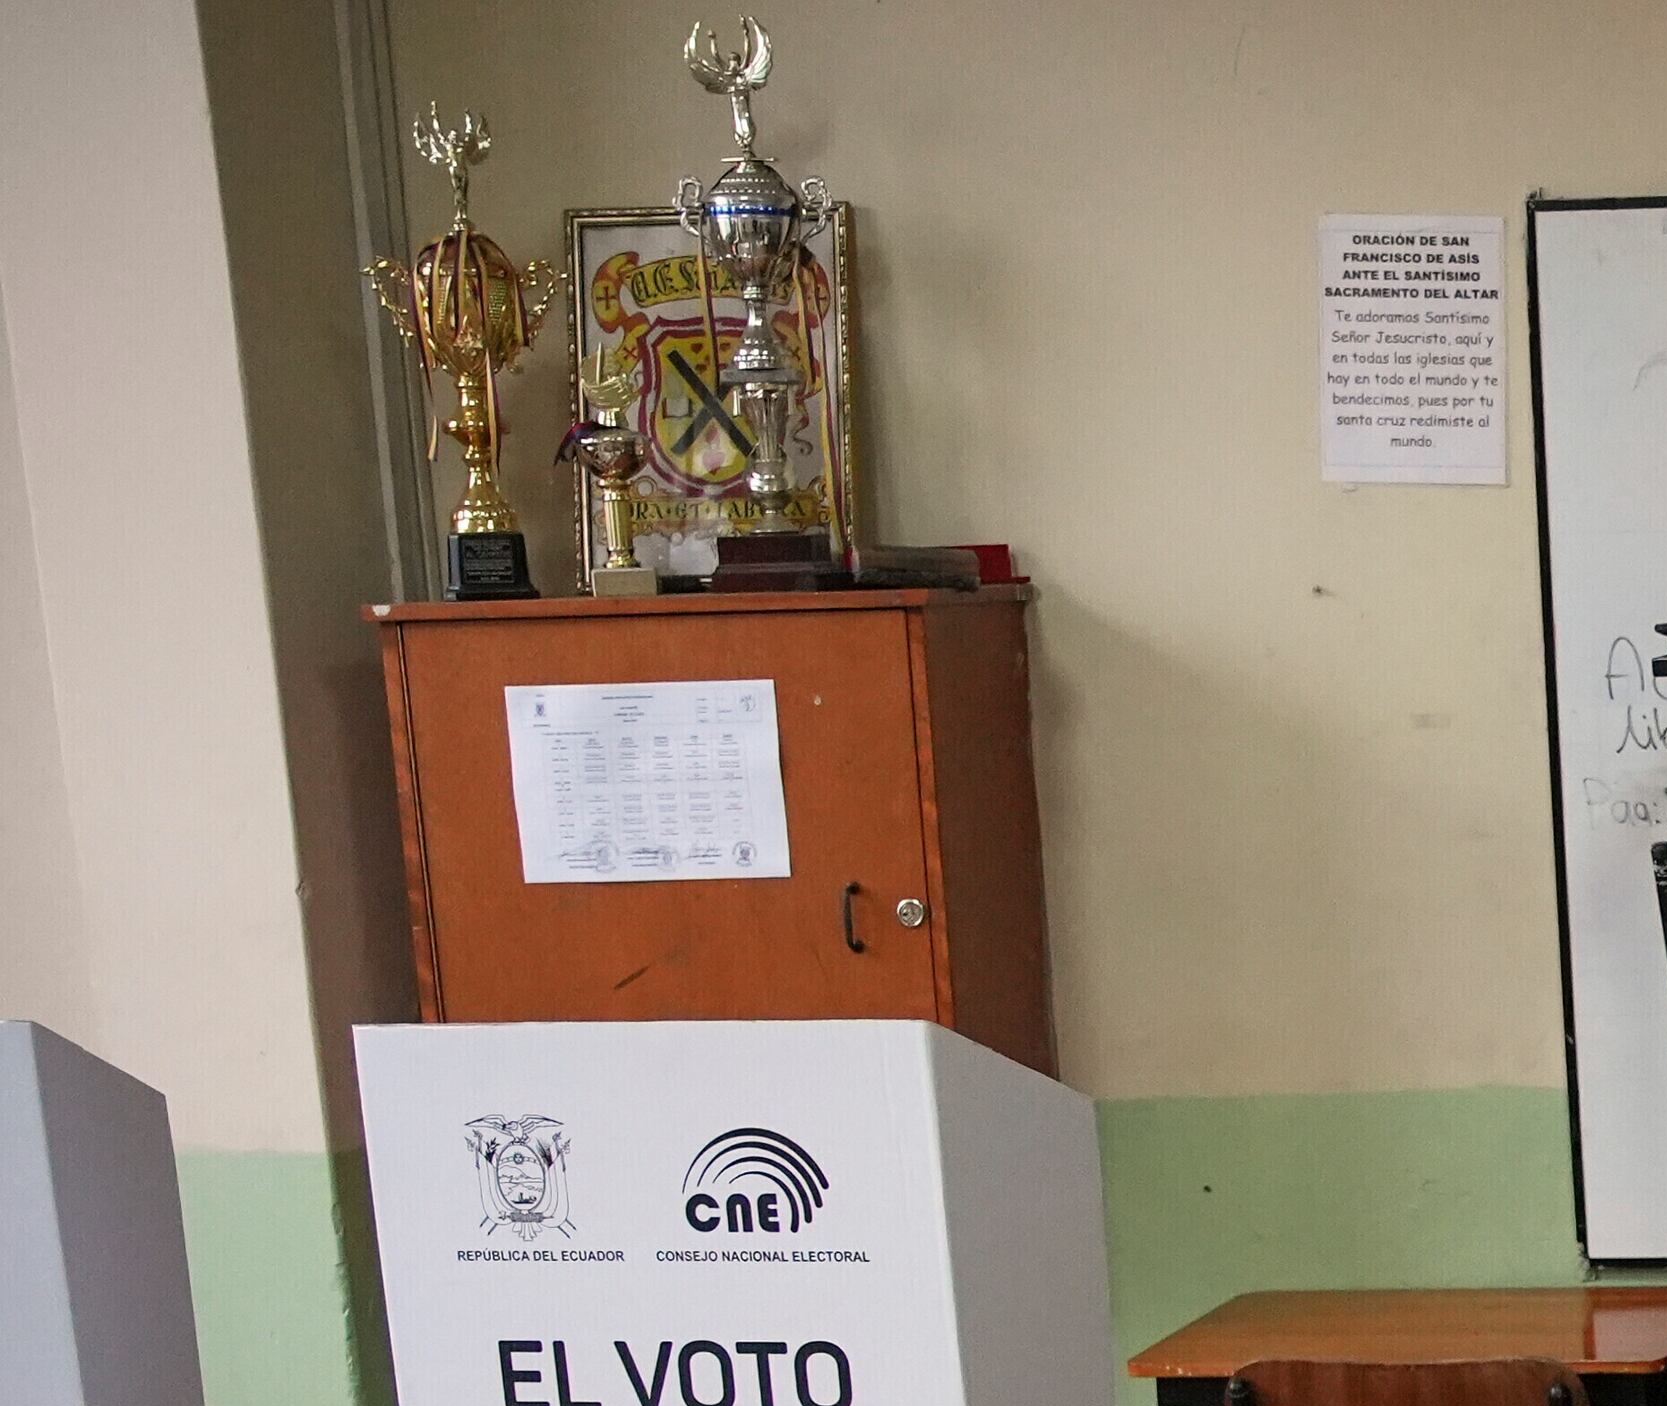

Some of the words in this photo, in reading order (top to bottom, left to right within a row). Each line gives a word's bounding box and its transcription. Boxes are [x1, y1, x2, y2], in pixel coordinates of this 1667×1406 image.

[686, 1194, 779, 1232] CNE
[457, 1247, 530, 1262] REPÚBLICA
[532, 1250, 558, 1262] DEL
[561, 1250, 625, 1262] ECUADOR
[656, 1250, 718, 1262] CONSEJO
[721, 1250, 789, 1263] NACIONAL
[792, 1250, 870, 1263] ELECTORAL
